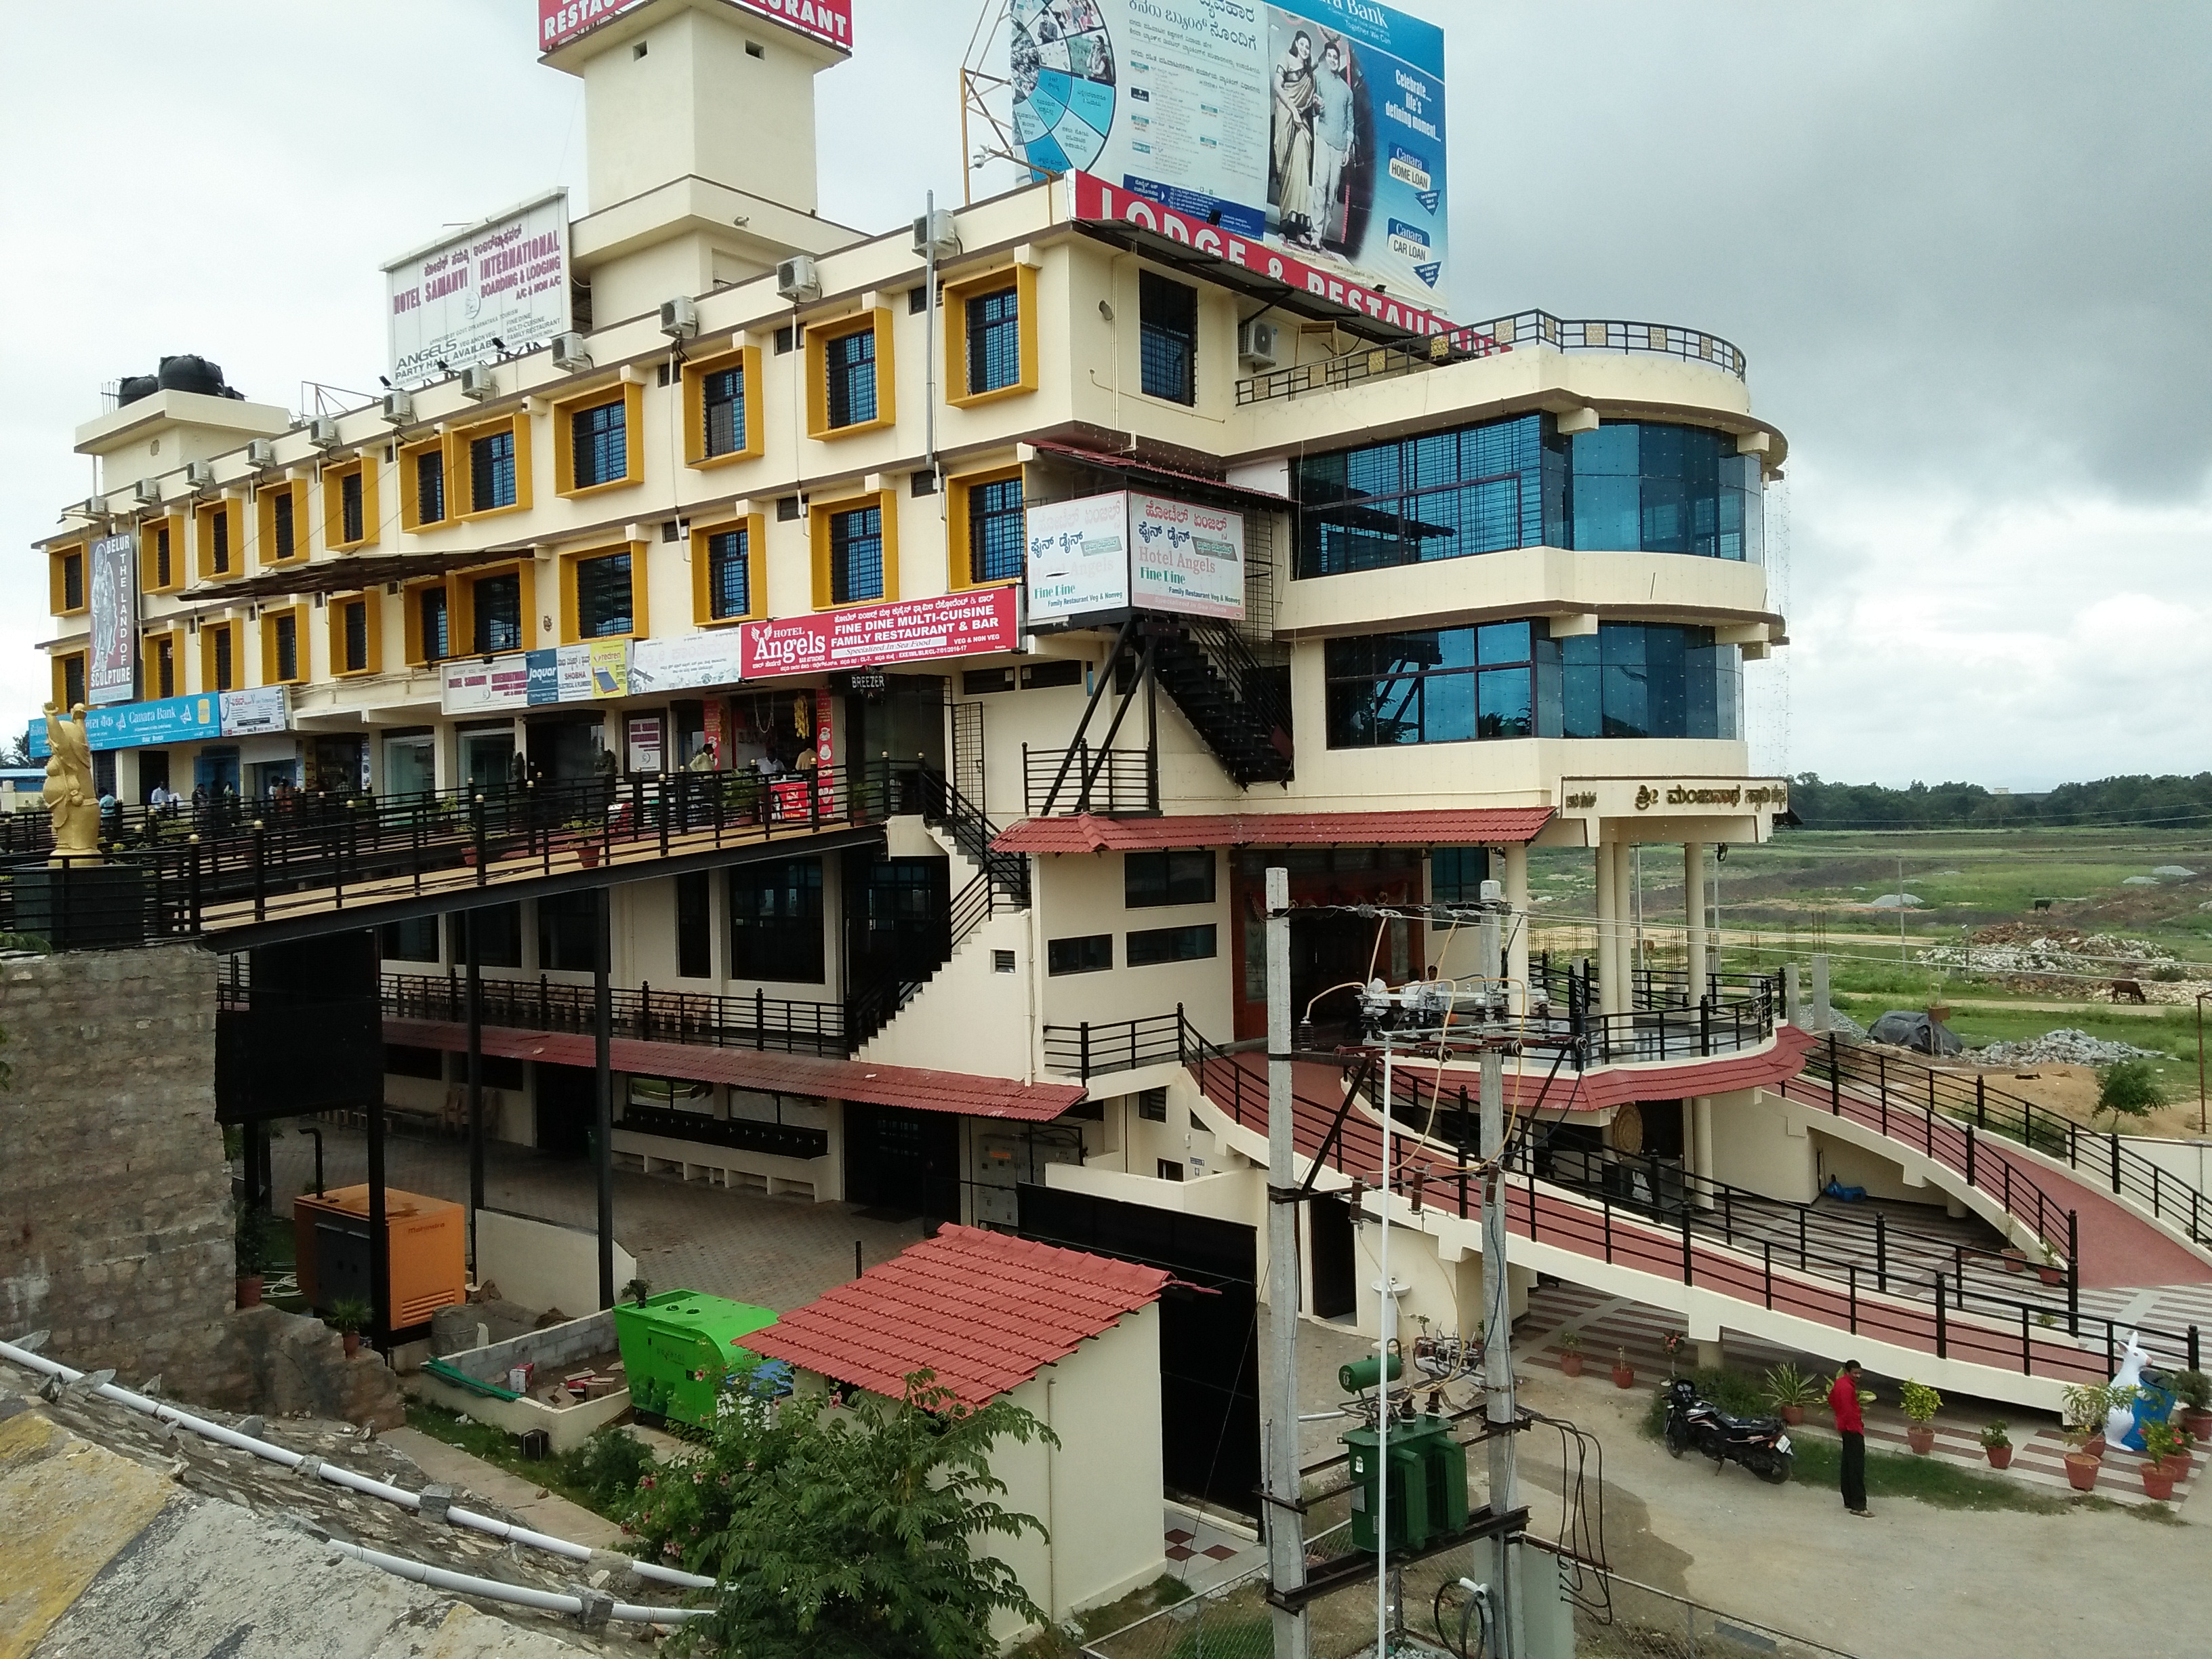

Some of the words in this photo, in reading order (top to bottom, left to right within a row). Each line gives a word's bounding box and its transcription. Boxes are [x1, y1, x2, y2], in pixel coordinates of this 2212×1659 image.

[1347, 0, 1389, 28] Bank
[1406, 91, 1422, 115] life's
[1385, 102, 1412, 129] defining
[1396, 147, 1422, 169] Canara
[1391, 162, 1411, 181] HOME
[1412, 172, 1428, 189] LOAN
[1396, 223, 1422, 244] Canara
[480, 230, 560, 281] INTERNATIONAL
[1393, 239, 1408, 255] CAR
[1409, 245, 1426, 262] LOAN
[480, 272, 518, 299] BOARDING
[520, 269, 526, 284] &
[526, 255, 561, 281] LODGING
[516, 287, 527, 300] A/C
[528, 285, 533, 296] &
[534, 279, 548, 293] NON
[549, 274, 562, 289] A/C
[394, 287, 422, 315] HOTEL
[425, 266, 468, 303] SAMANVI
[526, 317, 561, 334] RESTAURANT
[396, 338, 457, 370] ANGELS
[396, 363, 426, 380] PARTY
[453, 335, 504, 361] AVAILABE
[1145, 500, 1189, 524] ಹೋಟೆಲ್
[106, 534, 130, 555] BELUR
[1059, 531, 1084, 554] ಡೈನ್
[1138, 520, 1162, 544] ಫೈನ್
[1167, 526, 1191, 549] ಡೈನ್
[1071, 558, 1113, 577] Angels
[1139, 546, 1173, 566] Hotel
[1177, 550, 1216, 575] Angels
[1140, 566, 1162, 581] Fine
[1164, 570, 1186, 585] Dine
[1034, 587, 1054, 599] Fine
[1055, 583, 1076, 596] Dine
[1048, 598, 1063, 607] Family
[1063, 595, 1088, 605] Restaurant
[1089, 594, 1099, 602] Veg
[1105, 591, 1123, 599] Nonveg
[1168, 586, 1185, 597] Family
[1185, 589, 1210, 600] Restaurant
[1210, 593, 1220, 602] Veg
[1225, 595, 1241, 606] Nonveg
[119, 593, 127, 638] LAND
[834, 623, 862, 635] FINE
[865, 617, 894, 631] DINE
[898, 605, 994, 626] MULTI-CUISINE
[773, 627, 805, 638] HOTEL
[831, 633, 873, 647] FAMILY
[875, 622, 955, 642] RESTAURANT
[959, 621, 968, 632] &
[972, 617, 999, 630] BAR
[119, 643, 127, 665] OF
[754, 631, 826, 663] Angels
[846, 644, 885, 656] Specialized
[896, 641, 909, 649] Sea
[910, 638, 932, 647] Food
[91, 666, 131, 688] SCULPTURE
[528, 667, 557, 682] Jaquar
[564, 670, 587, 680] SHOBHA
[852, 675, 884, 689] BREEZER
[129, 711, 155, 724] Canara
[157, 706, 176, 720] Bank
[408, 1223, 445, 1234] Mahindra
